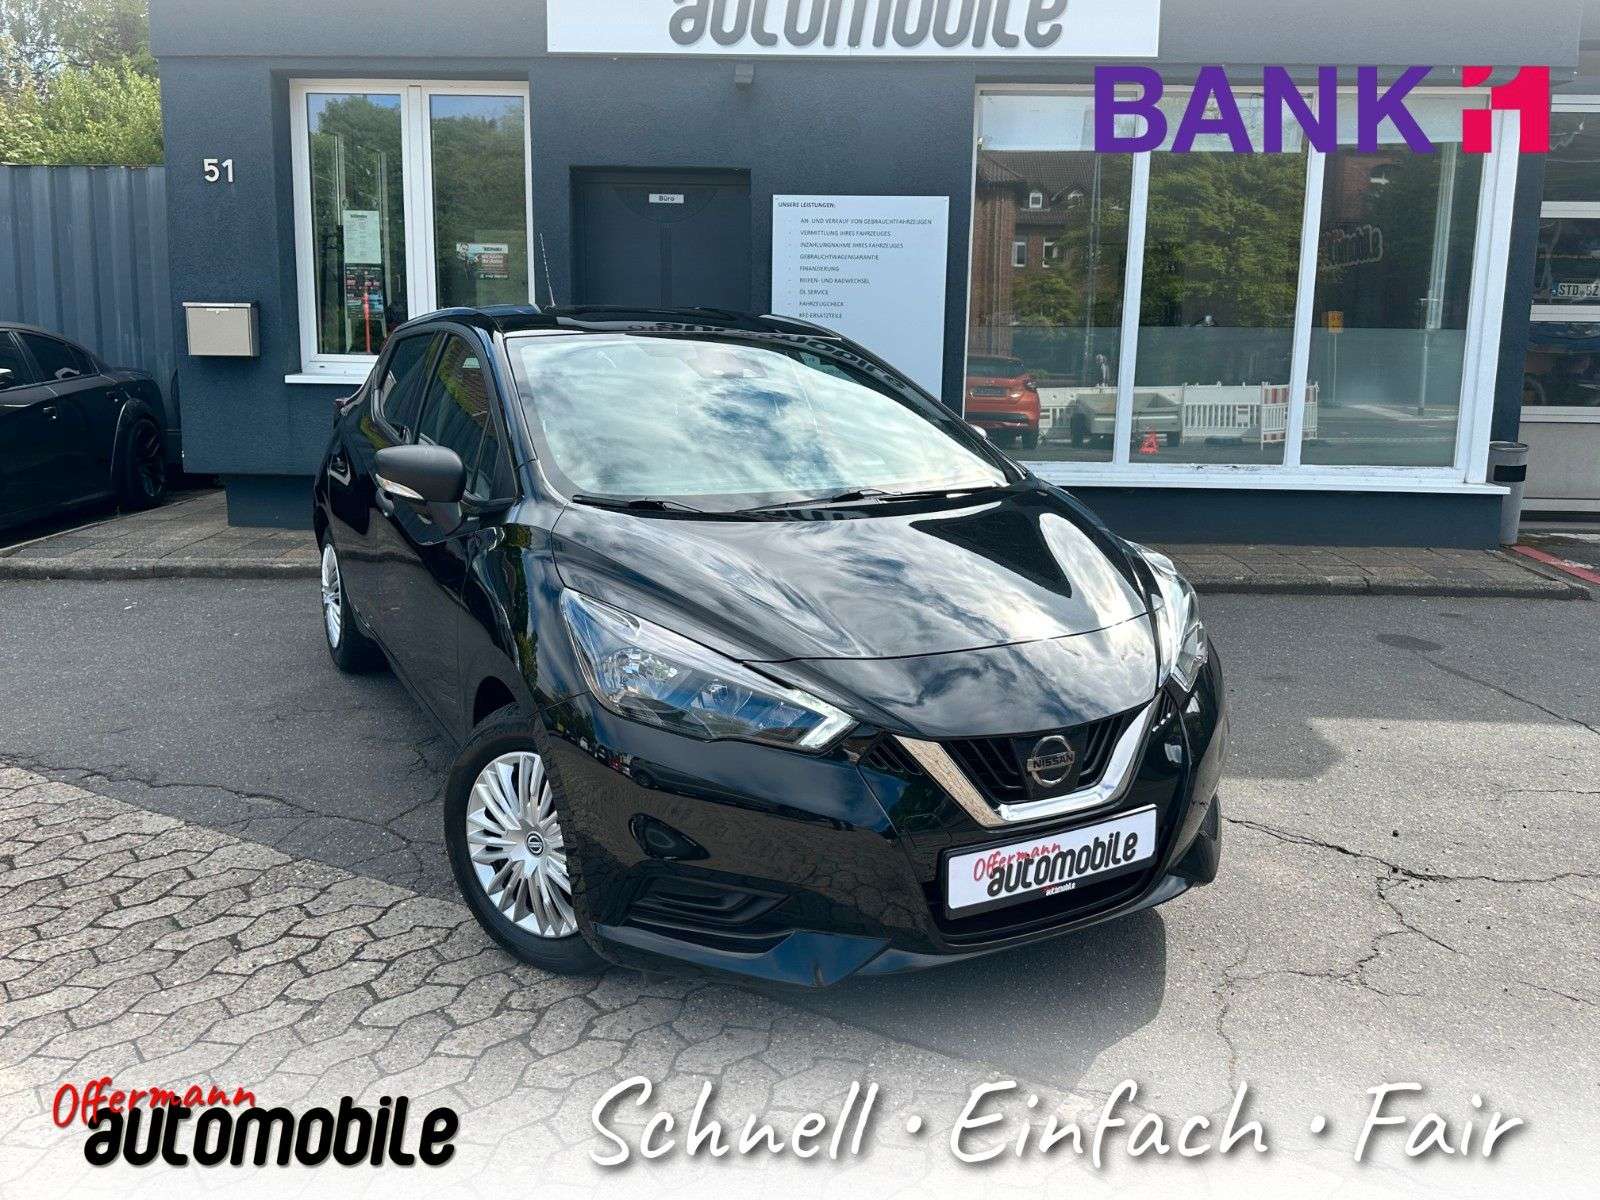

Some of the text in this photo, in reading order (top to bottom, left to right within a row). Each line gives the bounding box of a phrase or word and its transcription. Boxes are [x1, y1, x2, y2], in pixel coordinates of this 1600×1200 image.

[203, 158, 233, 183] 51
[1559, 284, 1579, 296] STD
[1033, 752, 1073, 768] NISSAN
[973, 842, 1061, 882] Offermann
[987, 831, 1139, 897] automobile
